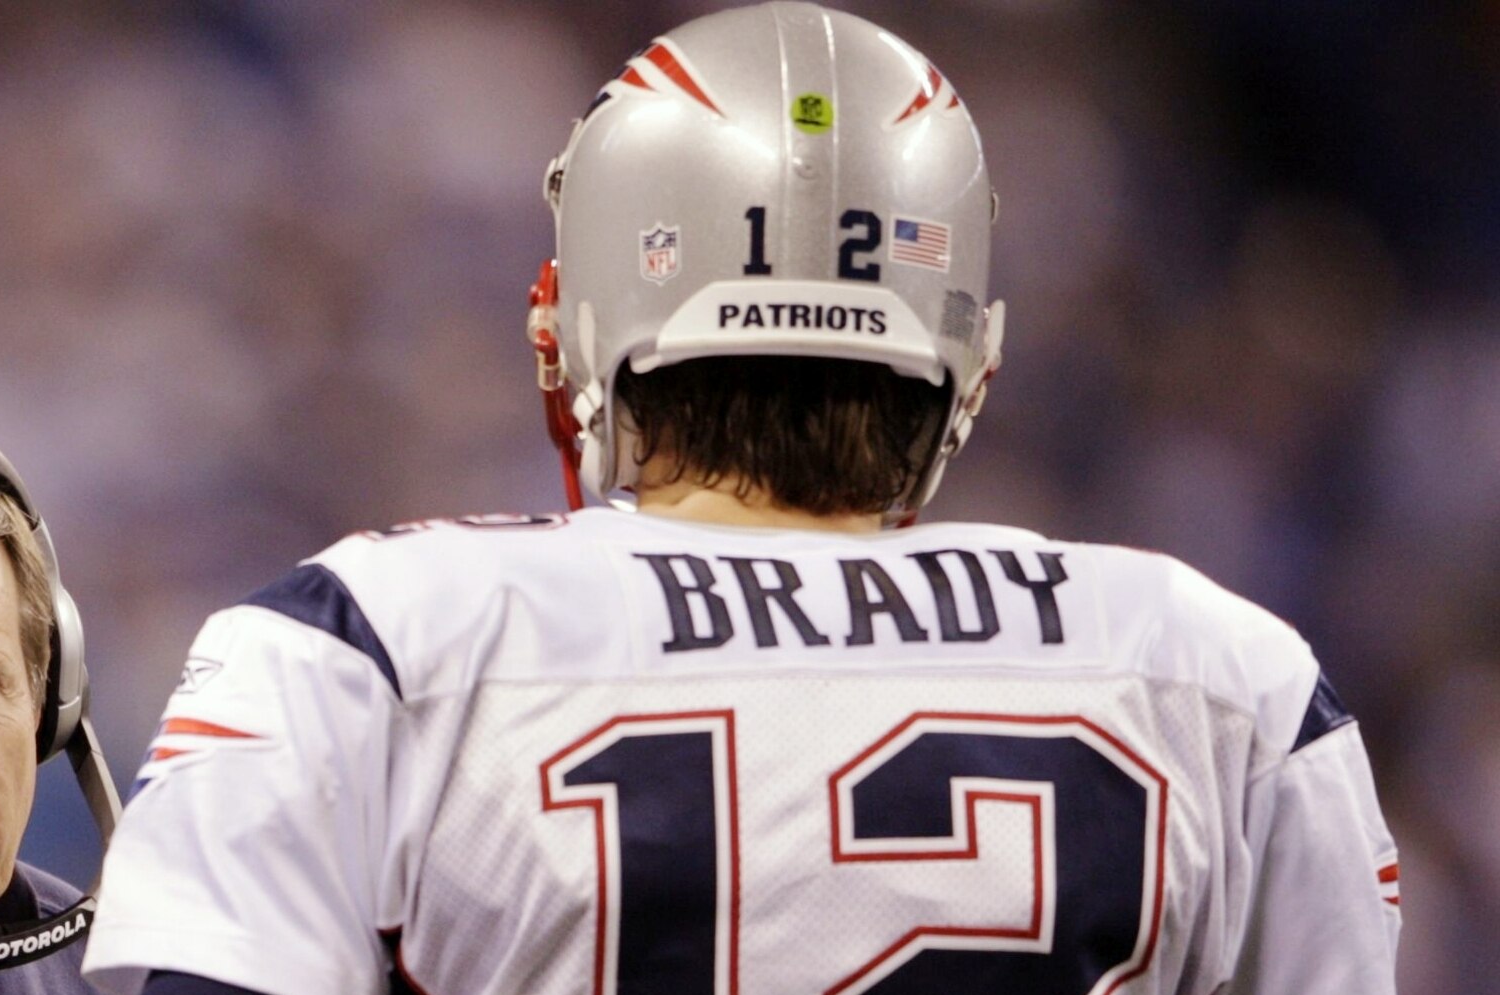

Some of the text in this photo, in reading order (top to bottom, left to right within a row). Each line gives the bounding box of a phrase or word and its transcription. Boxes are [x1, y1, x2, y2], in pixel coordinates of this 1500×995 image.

[743, 206, 882, 282] 1 2
[718, 303, 887, 334] PATRIOTS
[634, 548, 1069, 653] BRADY
